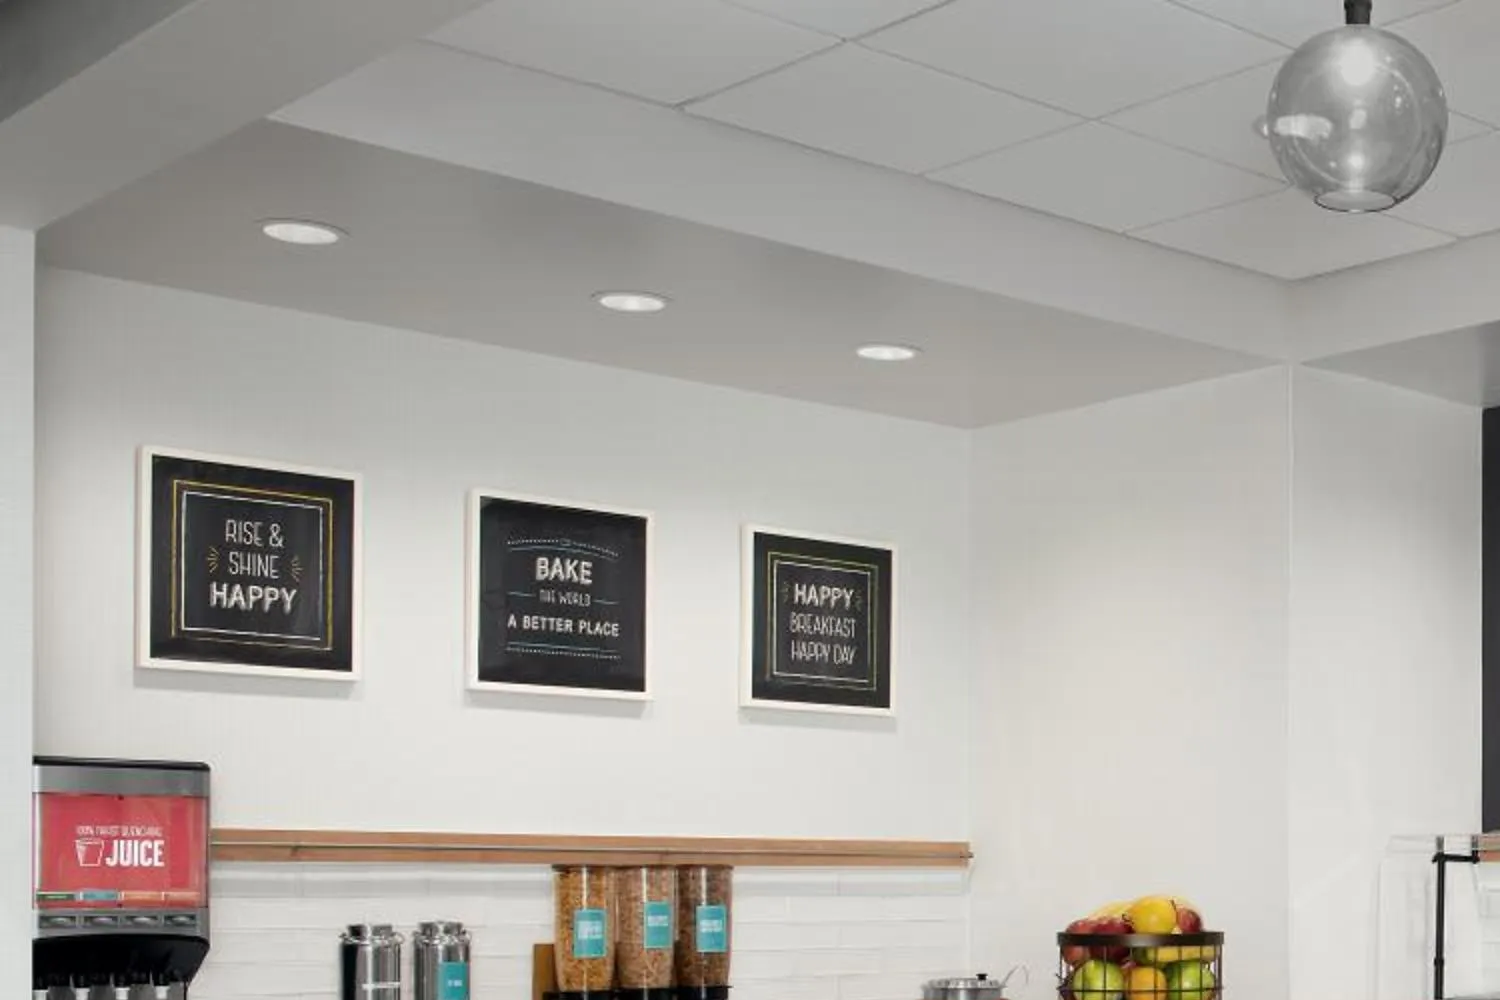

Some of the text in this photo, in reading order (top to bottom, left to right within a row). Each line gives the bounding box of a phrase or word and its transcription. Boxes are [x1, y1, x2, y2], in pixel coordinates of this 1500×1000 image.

[225, 519, 284, 547] RISE &
[228, 551, 280, 579] SHINE
[536, 557, 592, 584] BAKE
[209, 581, 297, 614] HAPPY
[793, 583, 854, 610] HAPPY
[507, 614, 620, 637] A BETTER PLACE
[790, 611, 856, 638] BREAKFAST
[791, 640, 857, 665] HAPPY DAY
[105, 839, 165, 867] JUICE
